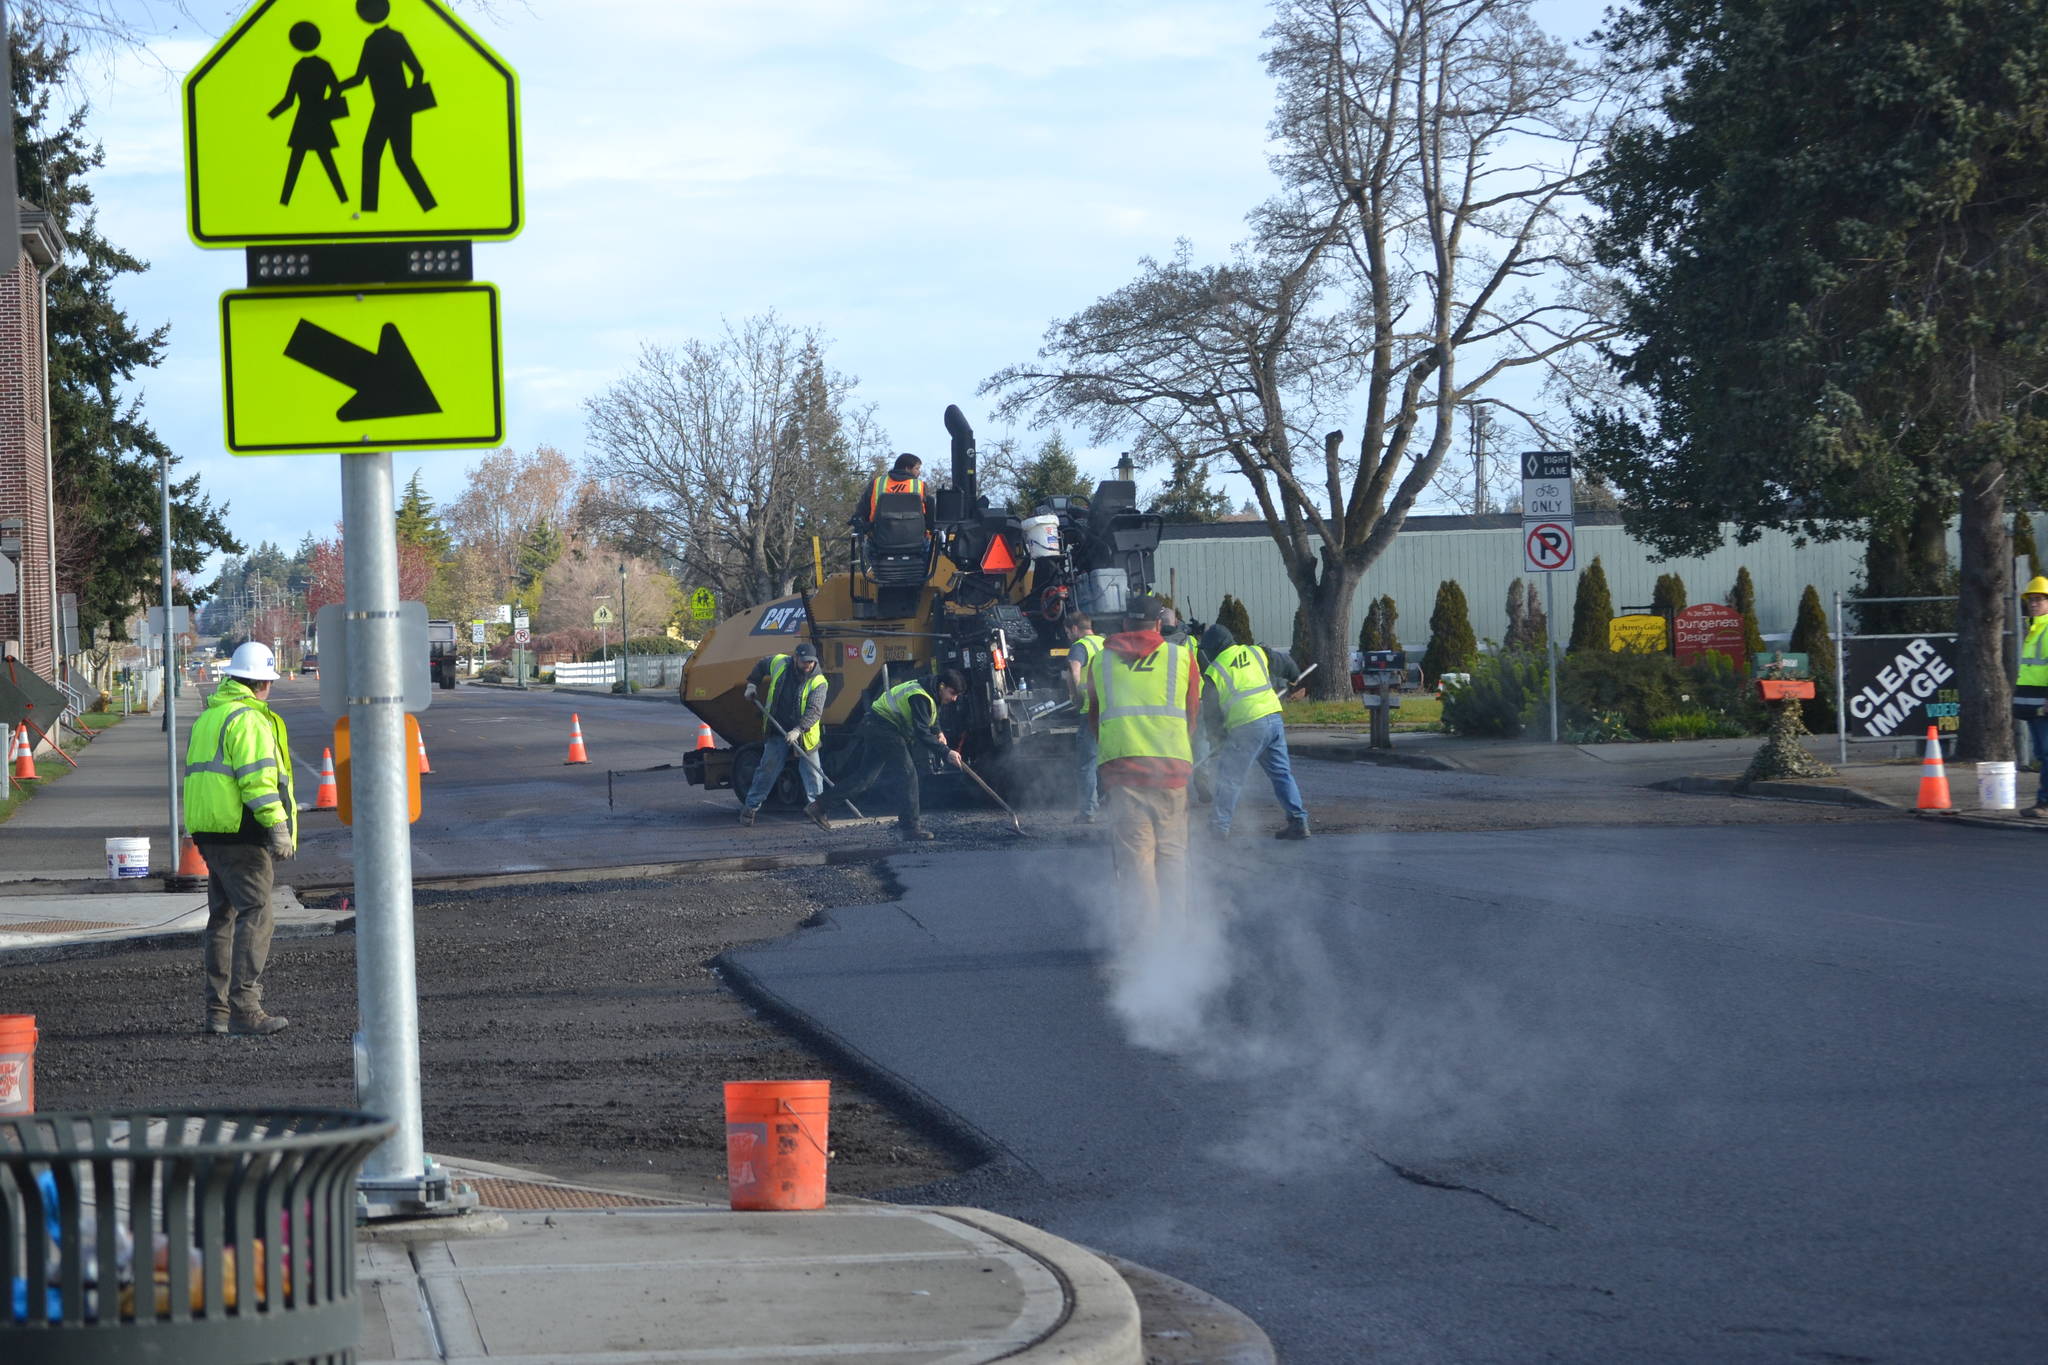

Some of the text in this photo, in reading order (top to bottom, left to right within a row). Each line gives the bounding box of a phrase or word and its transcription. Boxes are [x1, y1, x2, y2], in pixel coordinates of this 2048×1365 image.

[1543, 455, 1570, 464] RIGHT
[1544, 466, 1568, 475] LANE
[1531, 500, 1562, 513] ONLY
[1540, 532, 1562, 560] P
[760, 607, 797, 631] CAT
[1676, 618, 1739, 631] Dungeness
[1676, 631, 1717, 643] Design
[1849, 638, 1936, 719] CLEAR
[1864, 655, 1955, 737] IMAGE
